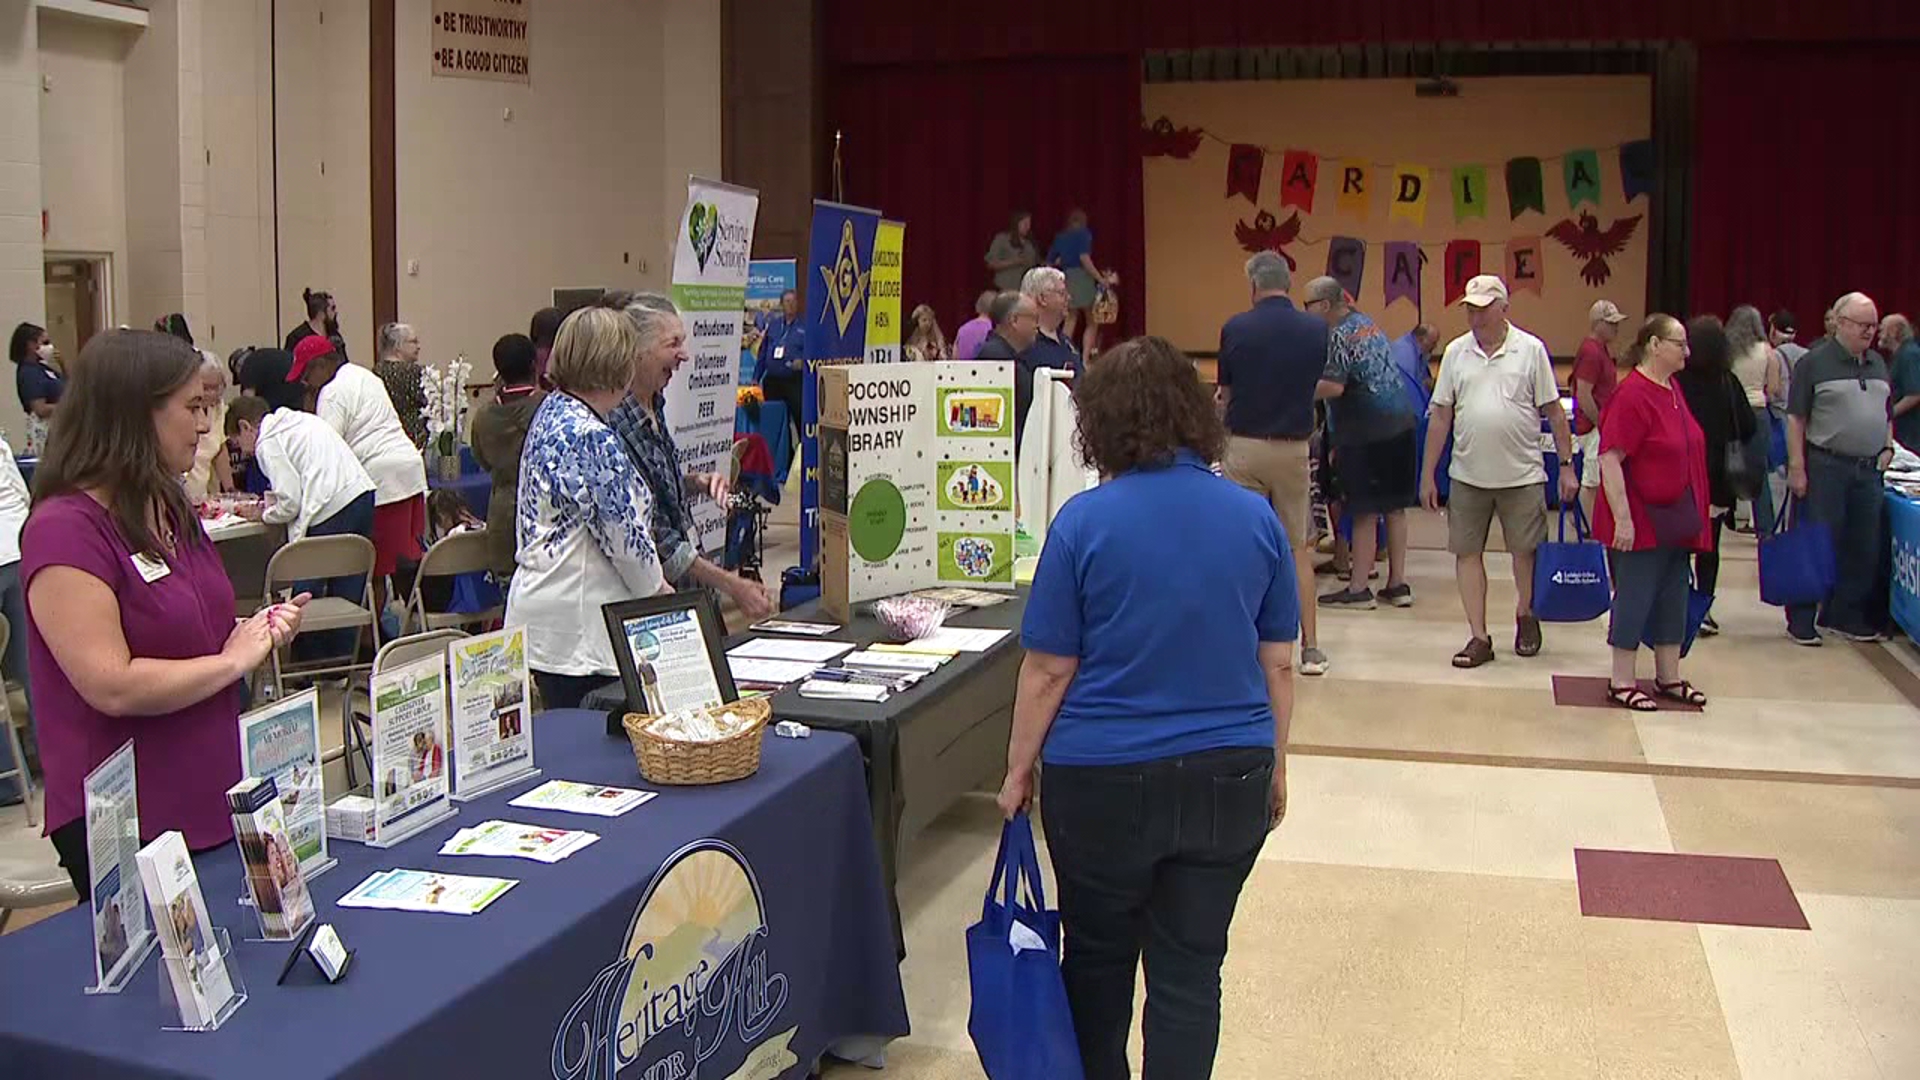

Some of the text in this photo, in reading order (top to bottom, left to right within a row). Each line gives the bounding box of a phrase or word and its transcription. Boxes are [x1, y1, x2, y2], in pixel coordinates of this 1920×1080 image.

[443, 12, 527, 39] BE TRUSTWORTHY
[441, 48, 528, 75] BE A GOOD CITIZEN
[718, 216, 748, 251] Serving
[693, 319, 734, 337] Ombudsman
[694, 353, 727, 371] Volunteer
[688, 371, 730, 390] Ombudsman
[848, 380, 911, 401] POCONO
[848, 404, 918, 429] OWNSHIP
[848, 429, 904, 453] IBRARY
[552, 925, 789, 1080] Heritage Hill
